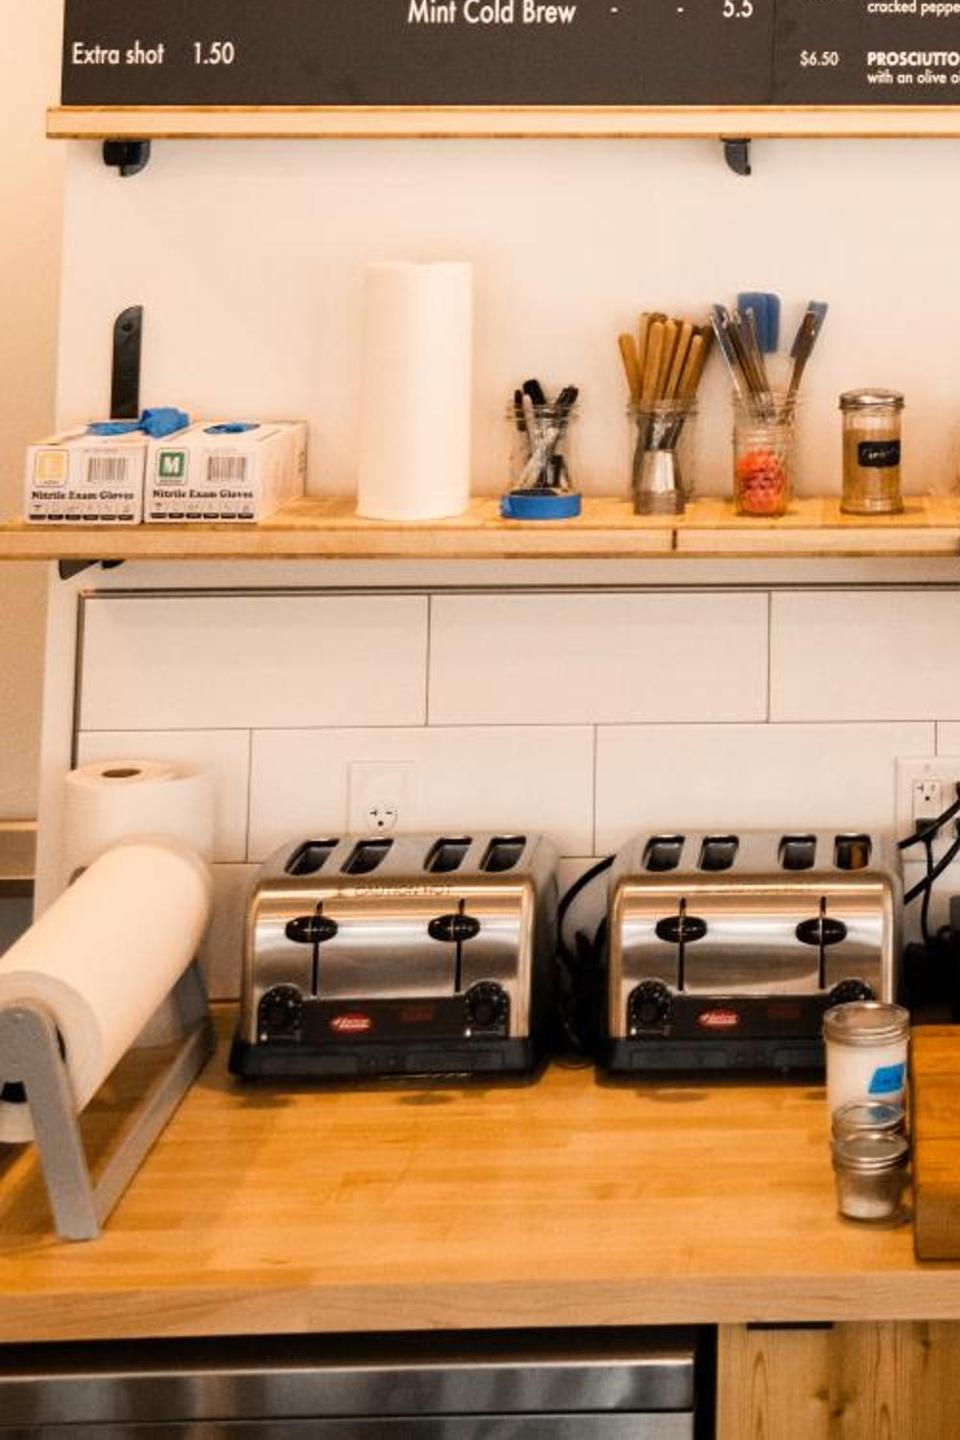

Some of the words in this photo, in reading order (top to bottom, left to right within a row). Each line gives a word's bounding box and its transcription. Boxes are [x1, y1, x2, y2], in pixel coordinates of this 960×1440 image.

[72, 42, 119, 64] Extra
[126, 40, 164, 64] shot
[194, 42, 234, 64] 1.50
[800, 50, 839, 66] $6.50
[867, 70, 893, 83] with
[897, 74, 913, 84] an
[917, 70, 947, 84] olive
[163, 456, 179, 473] M
[31, 490, 66, 500] Nitrile
[68, 491, 97, 500] Exam
[100, 490, 134, 500] Gloves
[152, 489, 186, 499] Nitrile
[189, 490, 217, 499] Exam
[220, 489, 253, 499] Gloves
